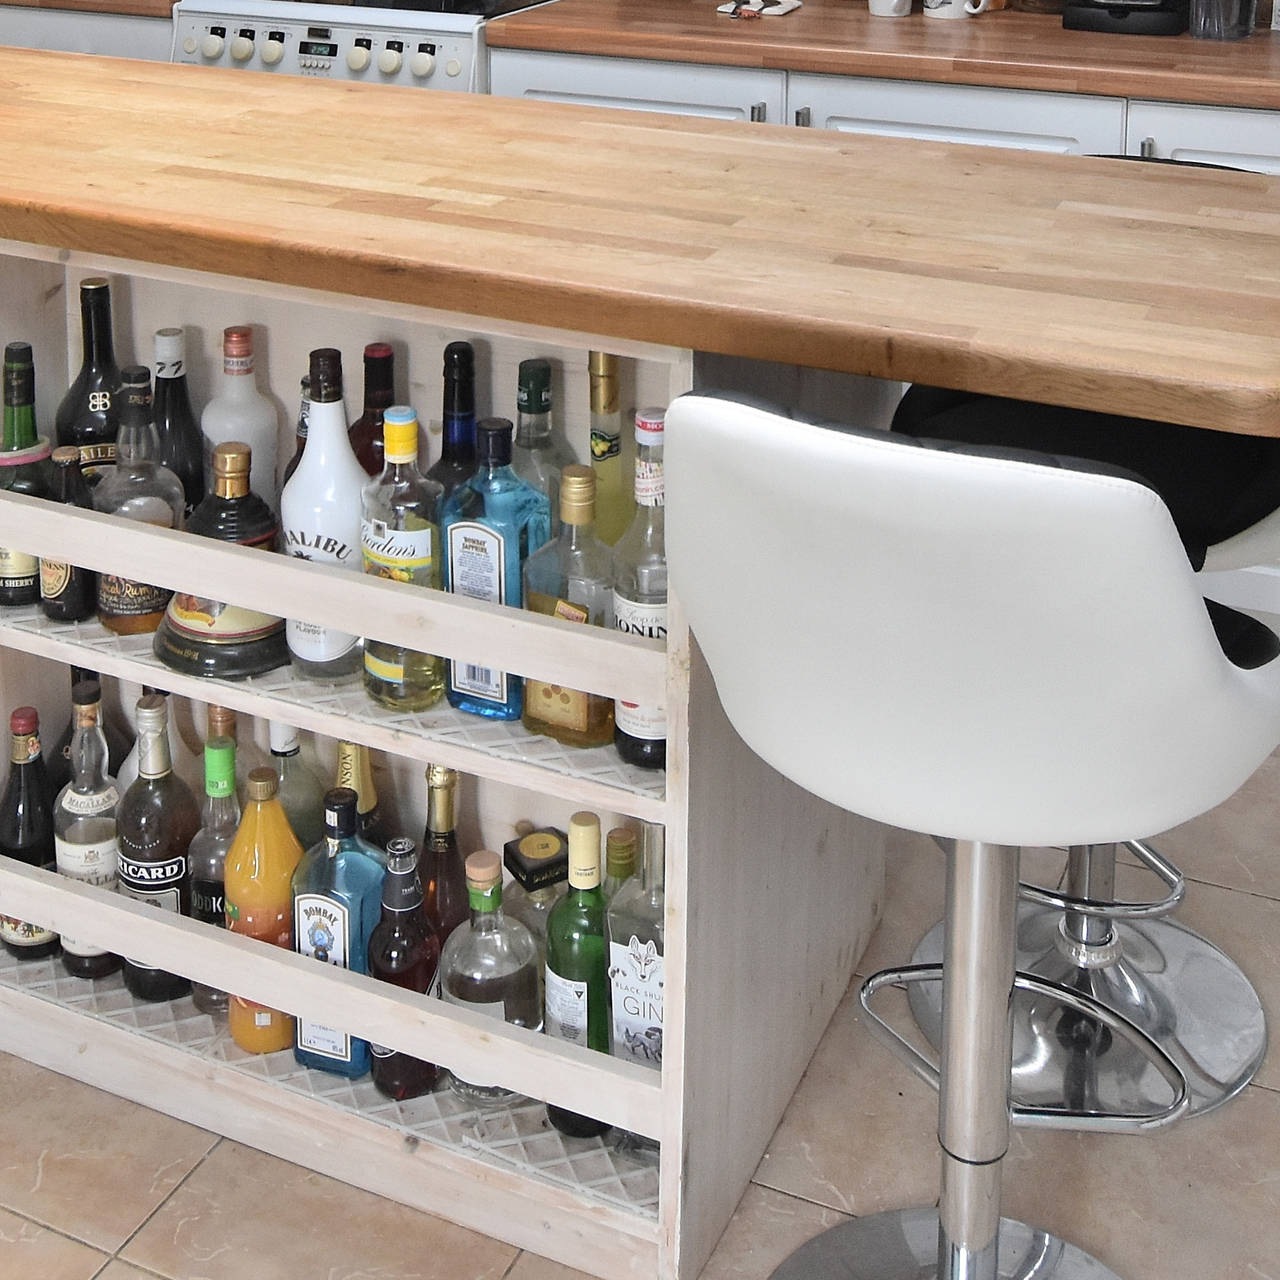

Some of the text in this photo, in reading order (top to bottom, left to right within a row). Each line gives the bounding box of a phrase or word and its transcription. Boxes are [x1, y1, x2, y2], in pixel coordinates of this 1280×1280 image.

[79, 445, 116, 461] AILE
[5, 576, 35, 588] SHERRY
[121, 583, 150, 598] Rum
[341, 753, 352, 787] NSON
[303, 905, 340, 927] BOMBAY
[615, 981, 664, 1001] BLACK SHU
[623, 995, 664, 1024] GIN
